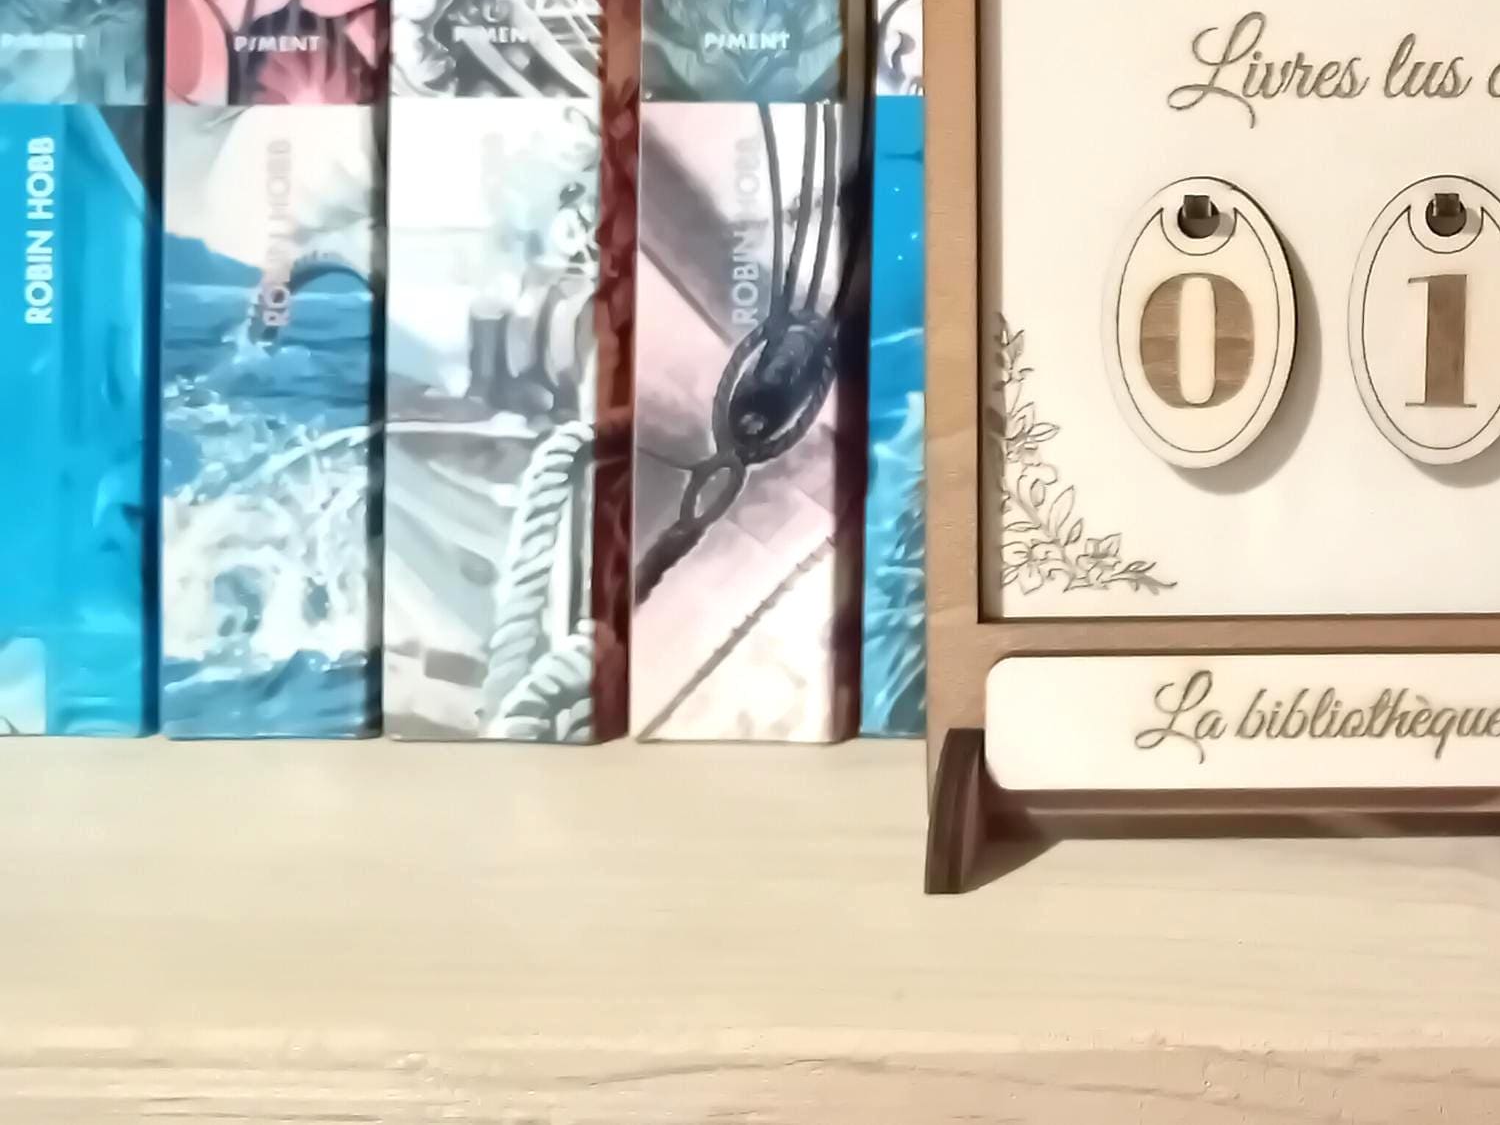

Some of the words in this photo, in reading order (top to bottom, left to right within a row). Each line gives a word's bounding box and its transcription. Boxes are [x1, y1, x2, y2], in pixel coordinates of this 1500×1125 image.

[1167, 10, 1370, 129] Livres
[1383, 32, 1472, 99] lus
[26, 135, 56, 219] HOBB
[24, 228, 54, 324] ROBIN
[730, 229, 761, 323] ROBIN
[1138, 272, 1255, 409] 0
[1405, 274, 1477, 408] 1
[1134, 669, 1227, 764] La
